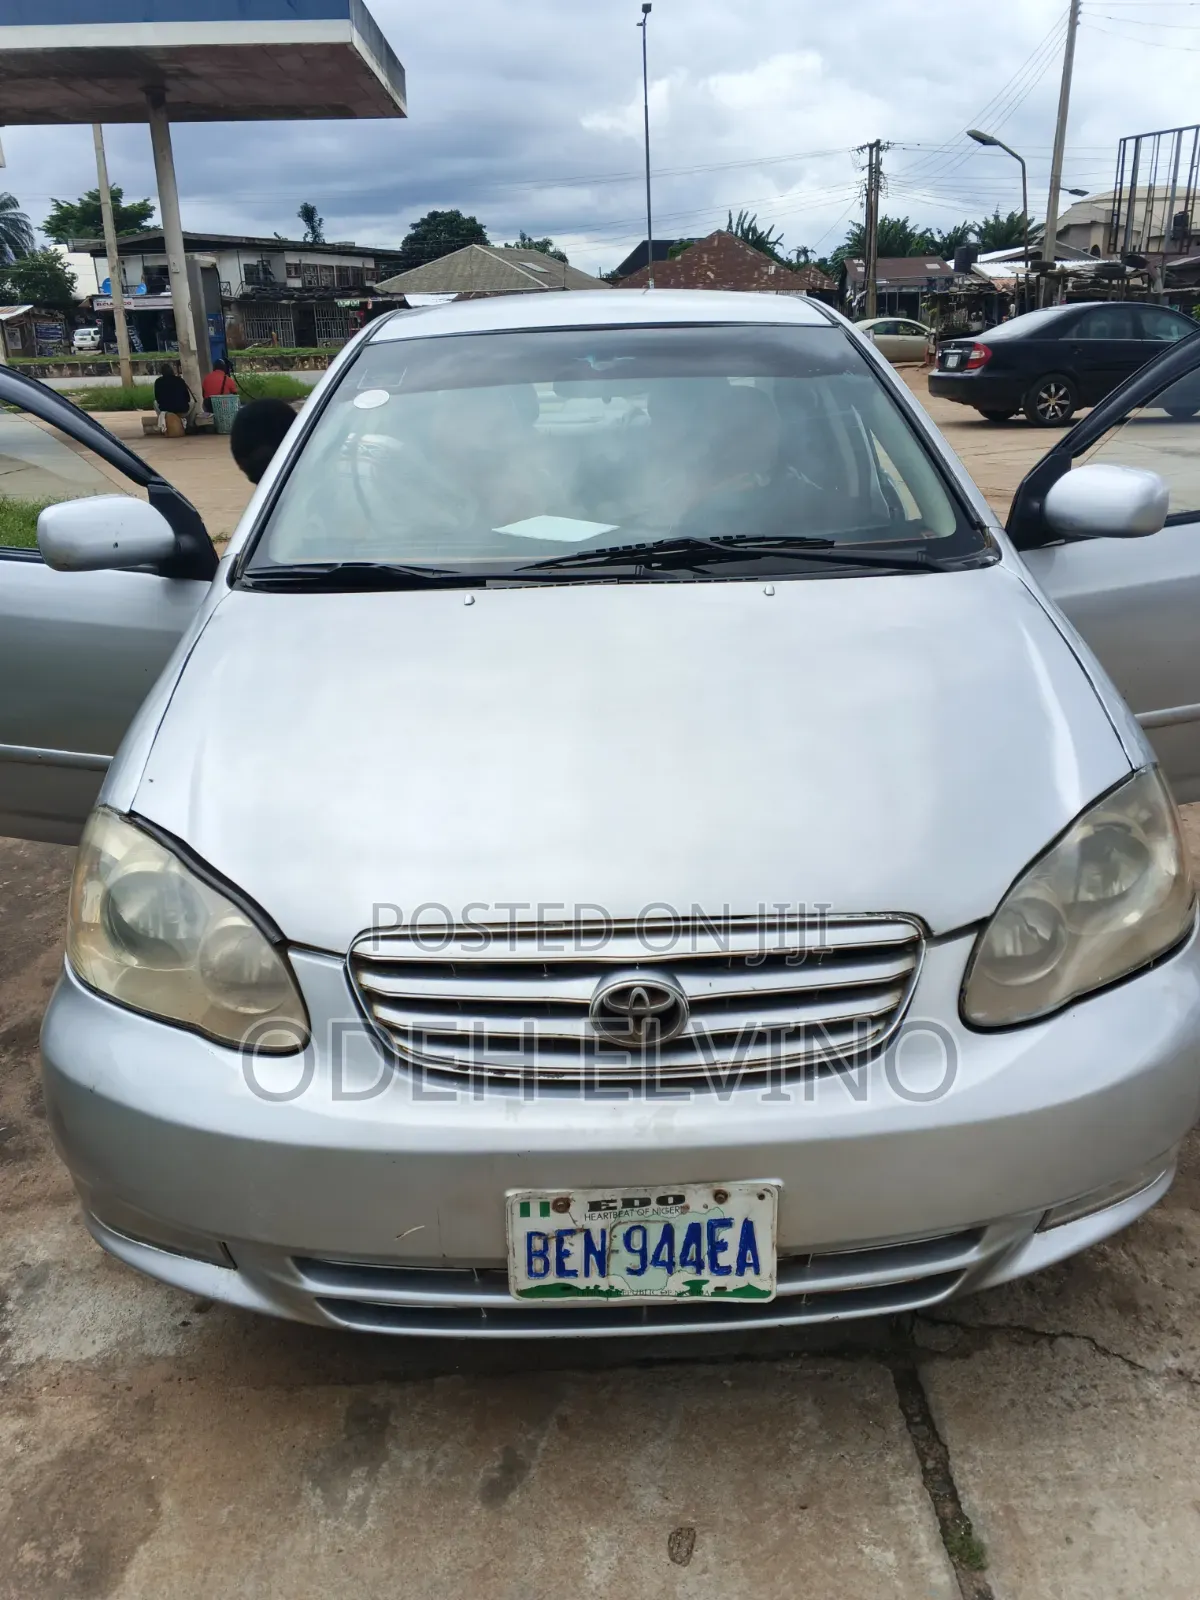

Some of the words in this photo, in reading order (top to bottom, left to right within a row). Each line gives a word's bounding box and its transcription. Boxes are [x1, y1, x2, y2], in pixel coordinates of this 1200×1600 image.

[587, 1194, 685, 1212] EDO
[584, 1208, 634, 1221] HEARTBEAT
[652, 1205, 690, 1216] NIGERI
